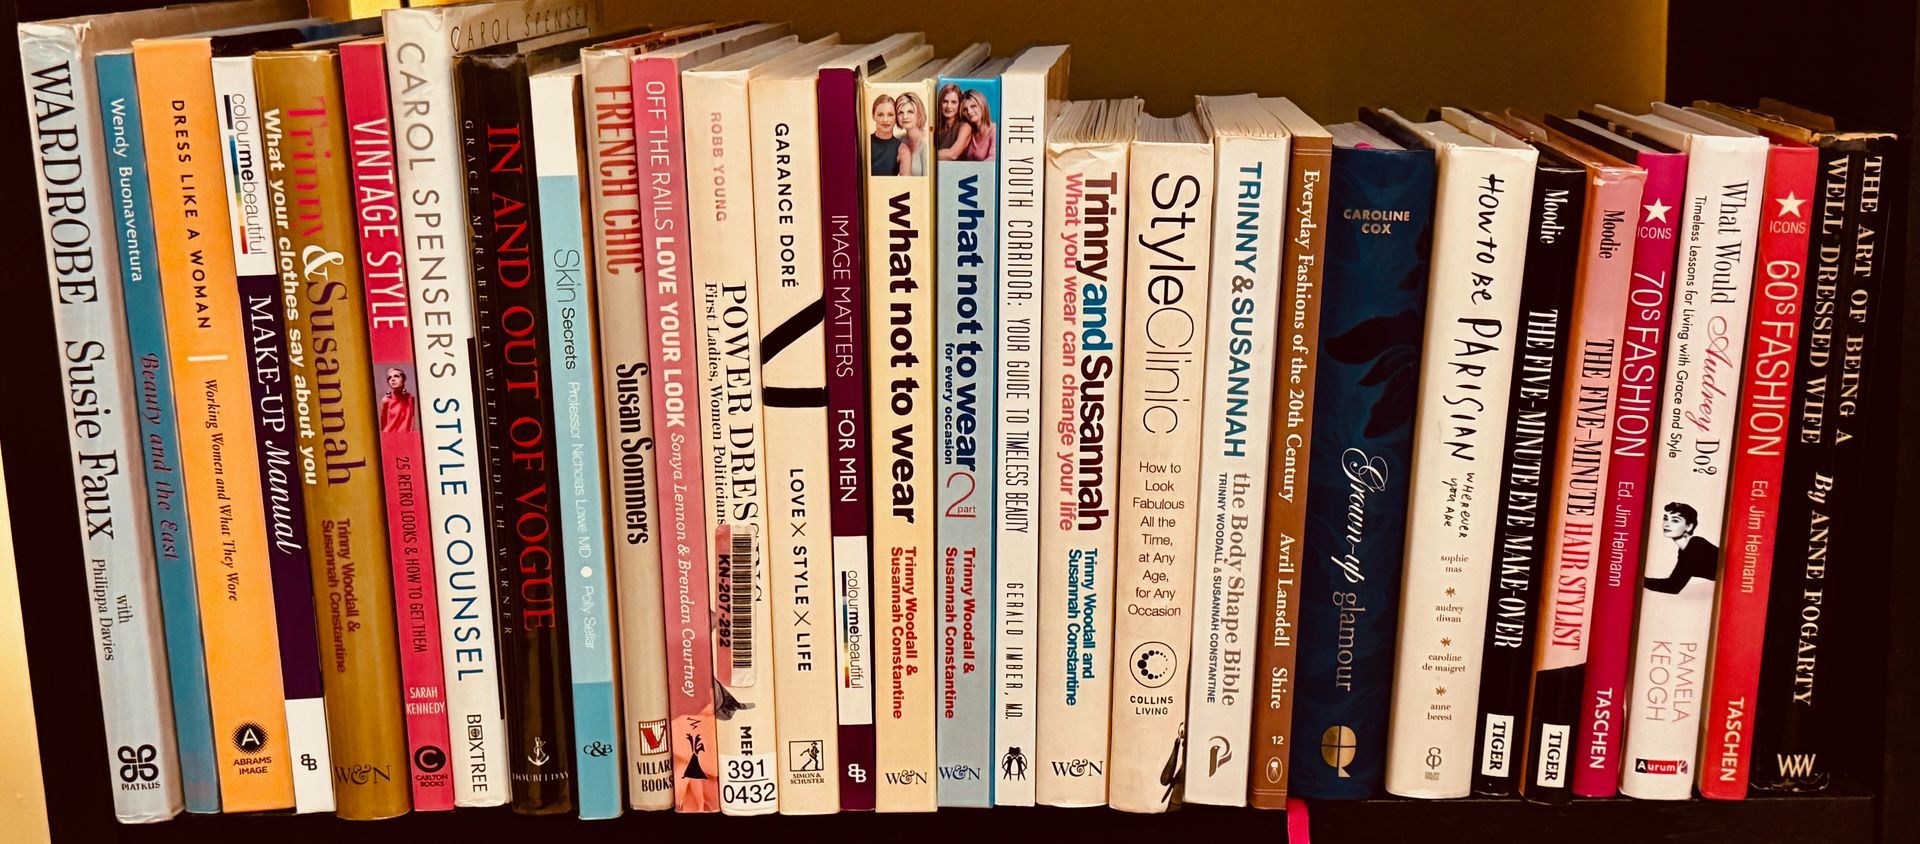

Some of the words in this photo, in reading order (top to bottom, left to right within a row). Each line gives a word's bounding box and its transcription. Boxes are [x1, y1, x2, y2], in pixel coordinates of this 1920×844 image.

[110, 97, 127, 158] Wendy
[397, 42, 435, 171] CAROL
[1009, 115, 1034, 144] THE
[172, 100, 192, 163] DRESS
[264, 108, 282, 172] What
[488, 122, 522, 174] IN
[595, 86, 637, 197] FRENCH
[711, 112, 723, 158] ROBB
[30, 60, 98, 305] WARDROBE
[181, 174, 199, 218] LIKE
[231, 93, 268, 256] colourmebeautiful
[351, 118, 399, 238] VINTAGE
[714, 165, 727, 222] YOUNG
[775, 122, 793, 225] GARANCE
[1008, 157, 1034, 208] YOUTH
[1822, 155, 1850, 235] WELL
[1860, 156, 1883, 213] THE
[118, 166, 142, 282] Buonaventura
[269, 178, 288, 231] your
[1294, 169, 1320, 250] Everyday
[1343, 209, 1410, 221] CAROLINE
[1540, 189, 1569, 244] Moodie
[1689, 195, 1707, 242] Timeless
[1718, 179, 1749, 234] What
[188, 229, 200, 241] A
[492, 192, 530, 289] AND
[602, 208, 643, 275] CHIC
[889, 191, 918, 293] what
[1361, 223, 1392, 234] COX
[1637, 226, 1672, 240] ICONS
[1853, 223, 1875, 277] ART
[279, 238, 299, 320] clothes
[412, 189, 456, 378] SPENSER'S
[554, 249, 581, 303] Skin
[780, 235, 799, 288] DORÉ
[1007, 220, 1033, 306] CORRIDOR:
[1682, 244, 1701, 287] Lessons
[1710, 241, 1742, 304] Would
[190, 250, 211, 329] WOMAN
[366, 244, 408, 329] STYLE
[1292, 254, 1315, 330] Fashions
[1684, 289, 1698, 305] for
[1809, 244, 1841, 368] DRESSED
[1849, 289, 1868, 323] OF
[289, 328, 304, 367] say
[562, 307, 577, 370] Secrets
[890, 303, 919, 368] not
[1007, 318, 1030, 352] YOUR
[1292, 334, 1308, 357] of
[1526, 309, 1558, 349] THE
[1677, 308, 1695, 340] Living
[249, 294, 286, 432] MAKE-UP
[501, 306, 540, 399] OUT
[944, 343, 955, 362] for
[1290, 358, 1308, 384] the
[1679, 342, 1690, 366] with
[1685, 315, 1733, 432] Audrey
[64, 340, 112, 439] Susie
[140, 353, 160, 425] Beauty
[616, 362, 648, 433] Susan
[891, 377, 920, 416] to
[943, 365, 954, 403] every
[1006, 361, 1030, 399] GUIDE
[1614, 325, 1659, 457] FASHION
[1675, 370, 1688, 405] Grace
[1838, 335, 1865, 418] BEING
[205, 379, 218, 429] Working
[295, 375, 315, 438] about
[1006, 408, 1030, 424] TO
[1287, 389, 1305, 428] 20th
[1510, 354, 1553, 486] FIVE-MINUTE
[1671, 407, 1682, 429] and
[1801, 377, 1827, 444] WIFE
[150, 433, 172, 473] and
[209, 432, 223, 475] Women
[433, 398, 467, 495] STYLE
[510, 416, 545, 470] OF
[944, 406, 953, 465] occasion
[1005, 431, 1029, 487] TIMELESS
[1669, 431, 1682, 459] Style
[1692, 438, 1720, 476] Do?
[1835, 428, 1853, 446] A
[216, 478, 231, 500] and
[300, 446, 316, 485] you
[891, 424, 915, 524] wear
[1139, 461, 1166, 474] How
[1169, 463, 1182, 474] to
[1145, 480, 1174, 491] Look
[1278, 433, 1303, 503] Century
[1807, 472, 1833, 504] By
[78, 449, 119, 541] Faux
[156, 481, 170, 511] the
[265, 440, 302, 555] Manual
[621, 437, 653, 545] Sommers
[1005, 492, 1028, 534] BEAUTY
[1132, 497, 1185, 510] Fabulous
[1507, 490, 1538, 527] EYE
[219, 505, 233, 536] What
[1140, 516, 1156, 527] All
[1158, 516, 1176, 528] the
[1331, 448, 1388, 584] Grown-up
[160, 520, 178, 560] East
[221, 540, 238, 568] They
[516, 484, 556, 633] VOGUE
[1138, 553, 1150, 562] at
[1152, 552, 1175, 565] Any
[1141, 534, 1173, 546] Time,
[1277, 533, 1296, 573] Avril
[1440, 554, 1469, 564] sophie
[1805, 510, 1830, 580] ANNE
[92, 559, 109, 613] Philippa
[226, 572, 239, 601] Wore
[1143, 570, 1169, 582] Age,
[1445, 565, 1462, 573] mas
[1494, 532, 1533, 648] MAKE-OVER
[116, 594, 133, 624] with
[444, 514, 483, 681] COUNSEL
[718, 554, 731, 648] KN-207-292
[1005, 582, 1024, 636] GERALD
[1128, 604, 1181, 617] Occasion
[1135, 587, 1150, 599] for
[1153, 588, 1176, 601] Any
[1274, 578, 1294, 647] Lansdell
[1435, 604, 1463, 615] audrey
[100, 617, 114, 661] Davies
[1333, 591, 1366, 691] glamour
[1436, 614, 1462, 623] diwan
[1004, 647, 1023, 695] IMBER,
[1428, 653, 1462, 662] caroline
[1435, 664, 1466, 673] maigret
[1793, 588, 1823, 707] FOGARTY
[410, 687, 438, 698] SARAH
[1130, 696, 1173, 704] COLLINS
[1270, 666, 1288, 709] Shire
[1645, 641, 1672, 722] KEOGH
[1672, 642, 1697, 723] PAMELA
[406, 702, 445, 714] KENNEDY
[1005, 703, 1023, 720] M.D.
[1135, 707, 1168, 715] LIVING
[1427, 713, 1452, 721] berest
[1590, 687, 1613, 769] TASCHEN
[233, 756, 272, 766] ABRAMS
[1272, 735, 1284, 744] 12
[239, 766, 268, 775] IMAGE
[728, 759, 766, 779] 391
[723, 783, 775, 803] 0432
